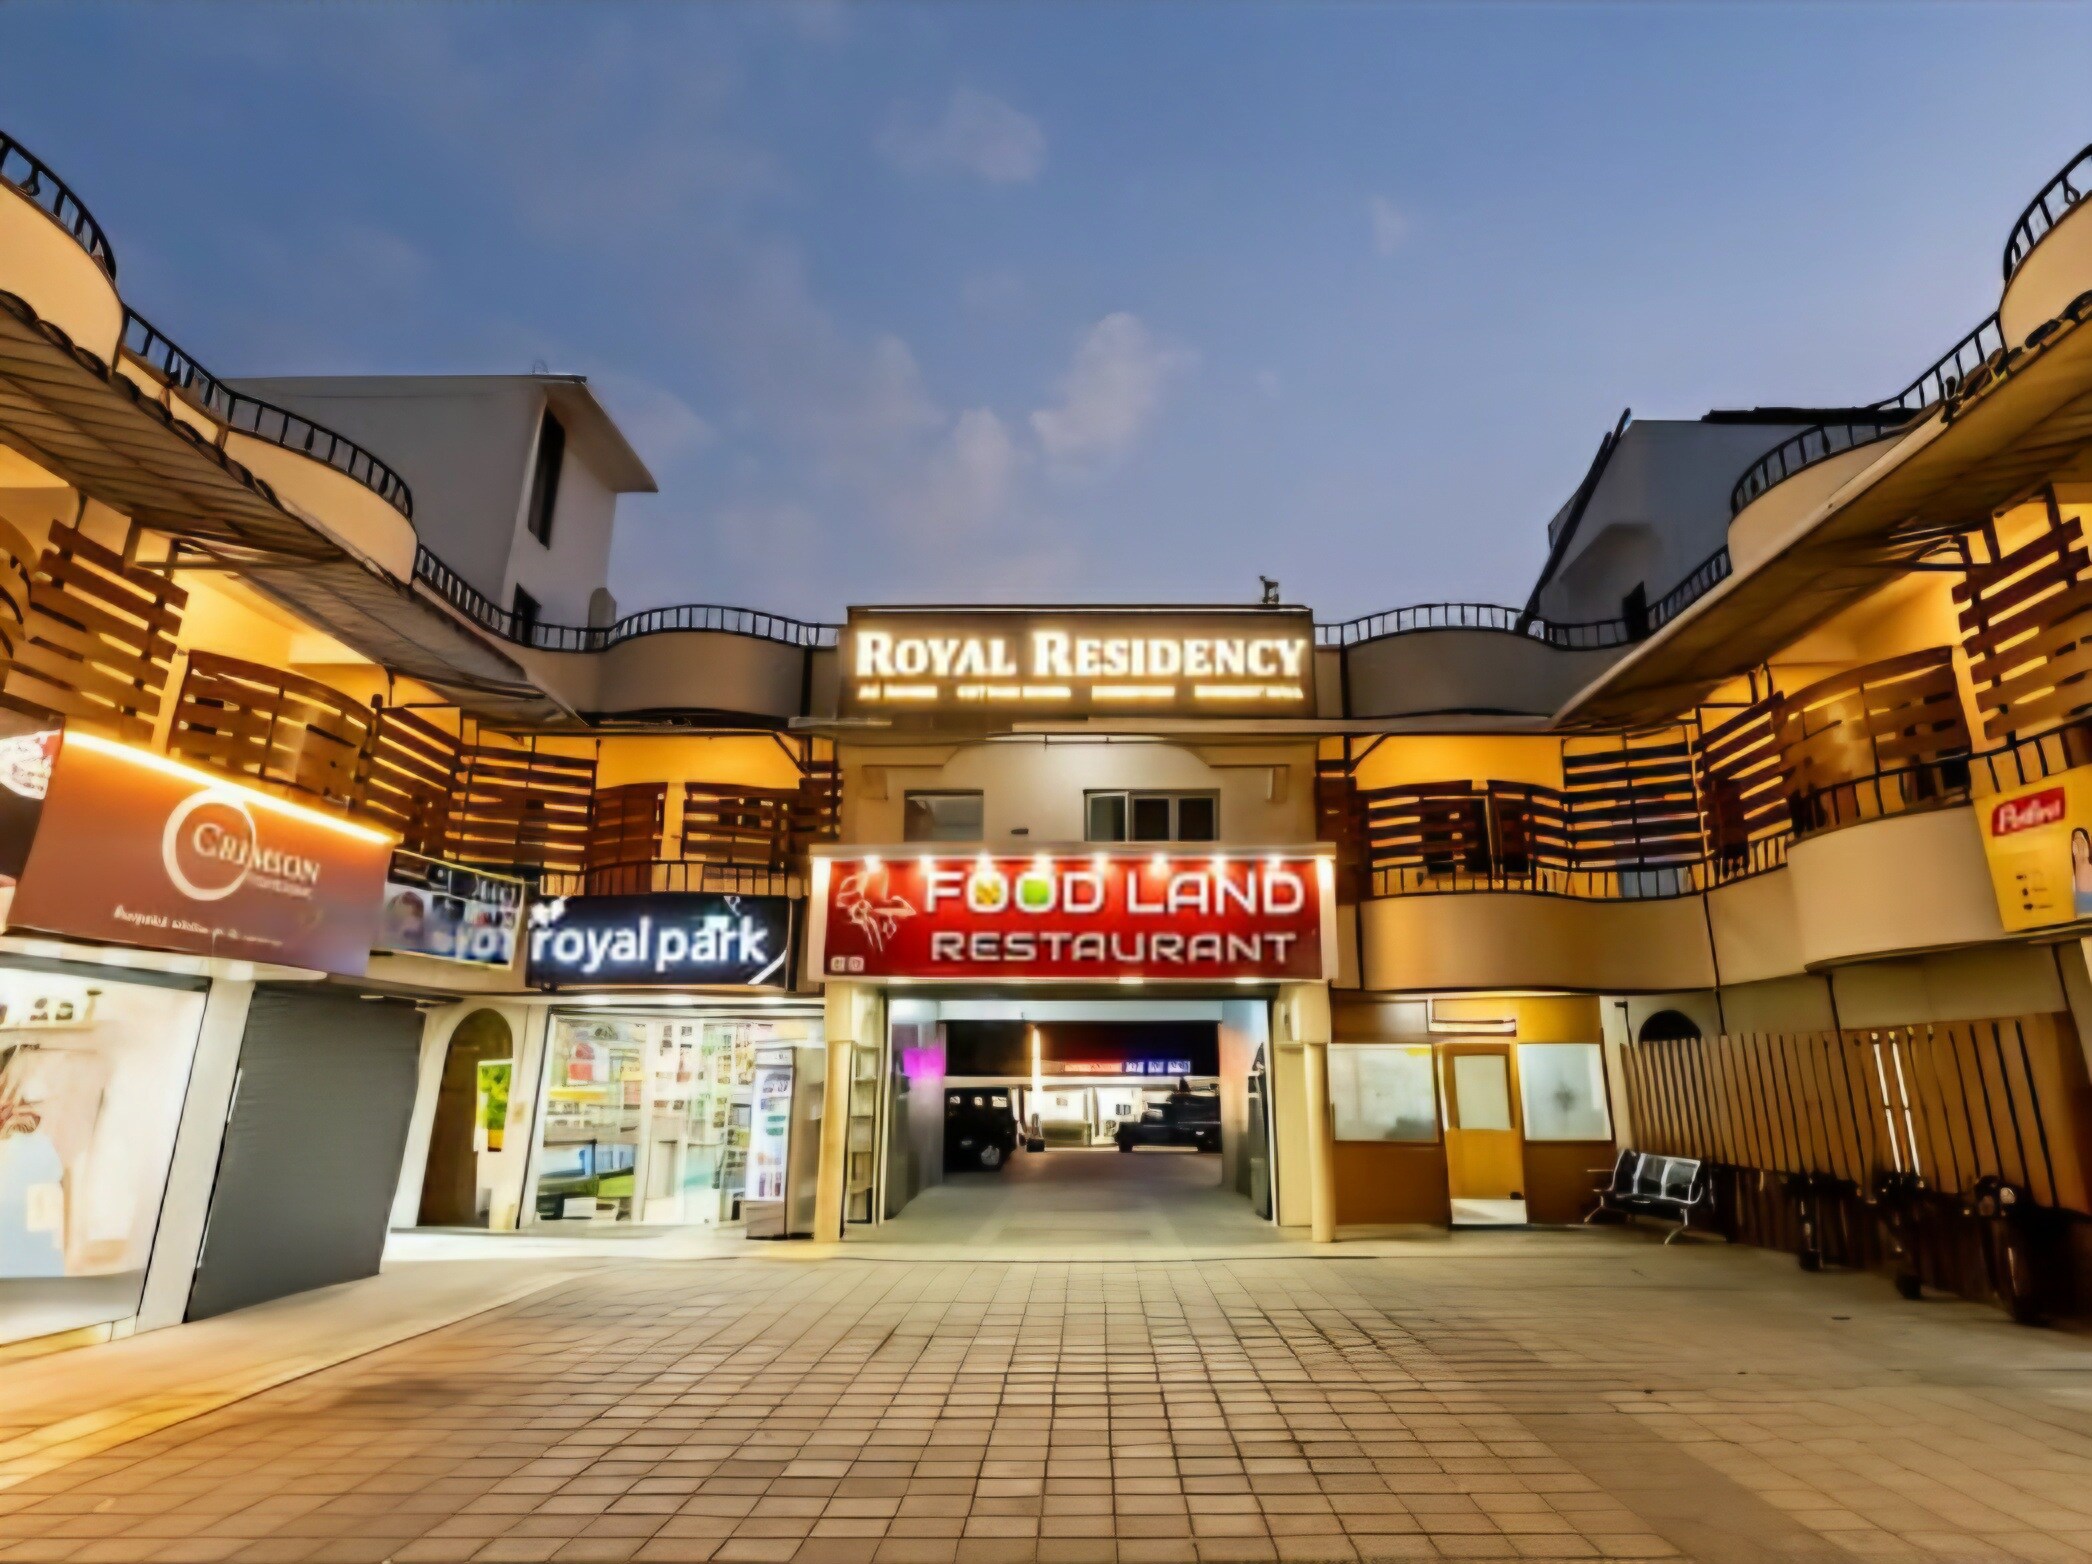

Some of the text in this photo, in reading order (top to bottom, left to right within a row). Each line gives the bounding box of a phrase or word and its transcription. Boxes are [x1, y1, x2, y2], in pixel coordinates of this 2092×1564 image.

[856, 631, 1307, 677] ROYAL RESIDENCY
[925, 870, 1304, 915] FOOD LAND
[531, 915, 650, 974] royal
[655, 915, 768, 973] park
[931, 931, 1297, 963] RESTAURANT
